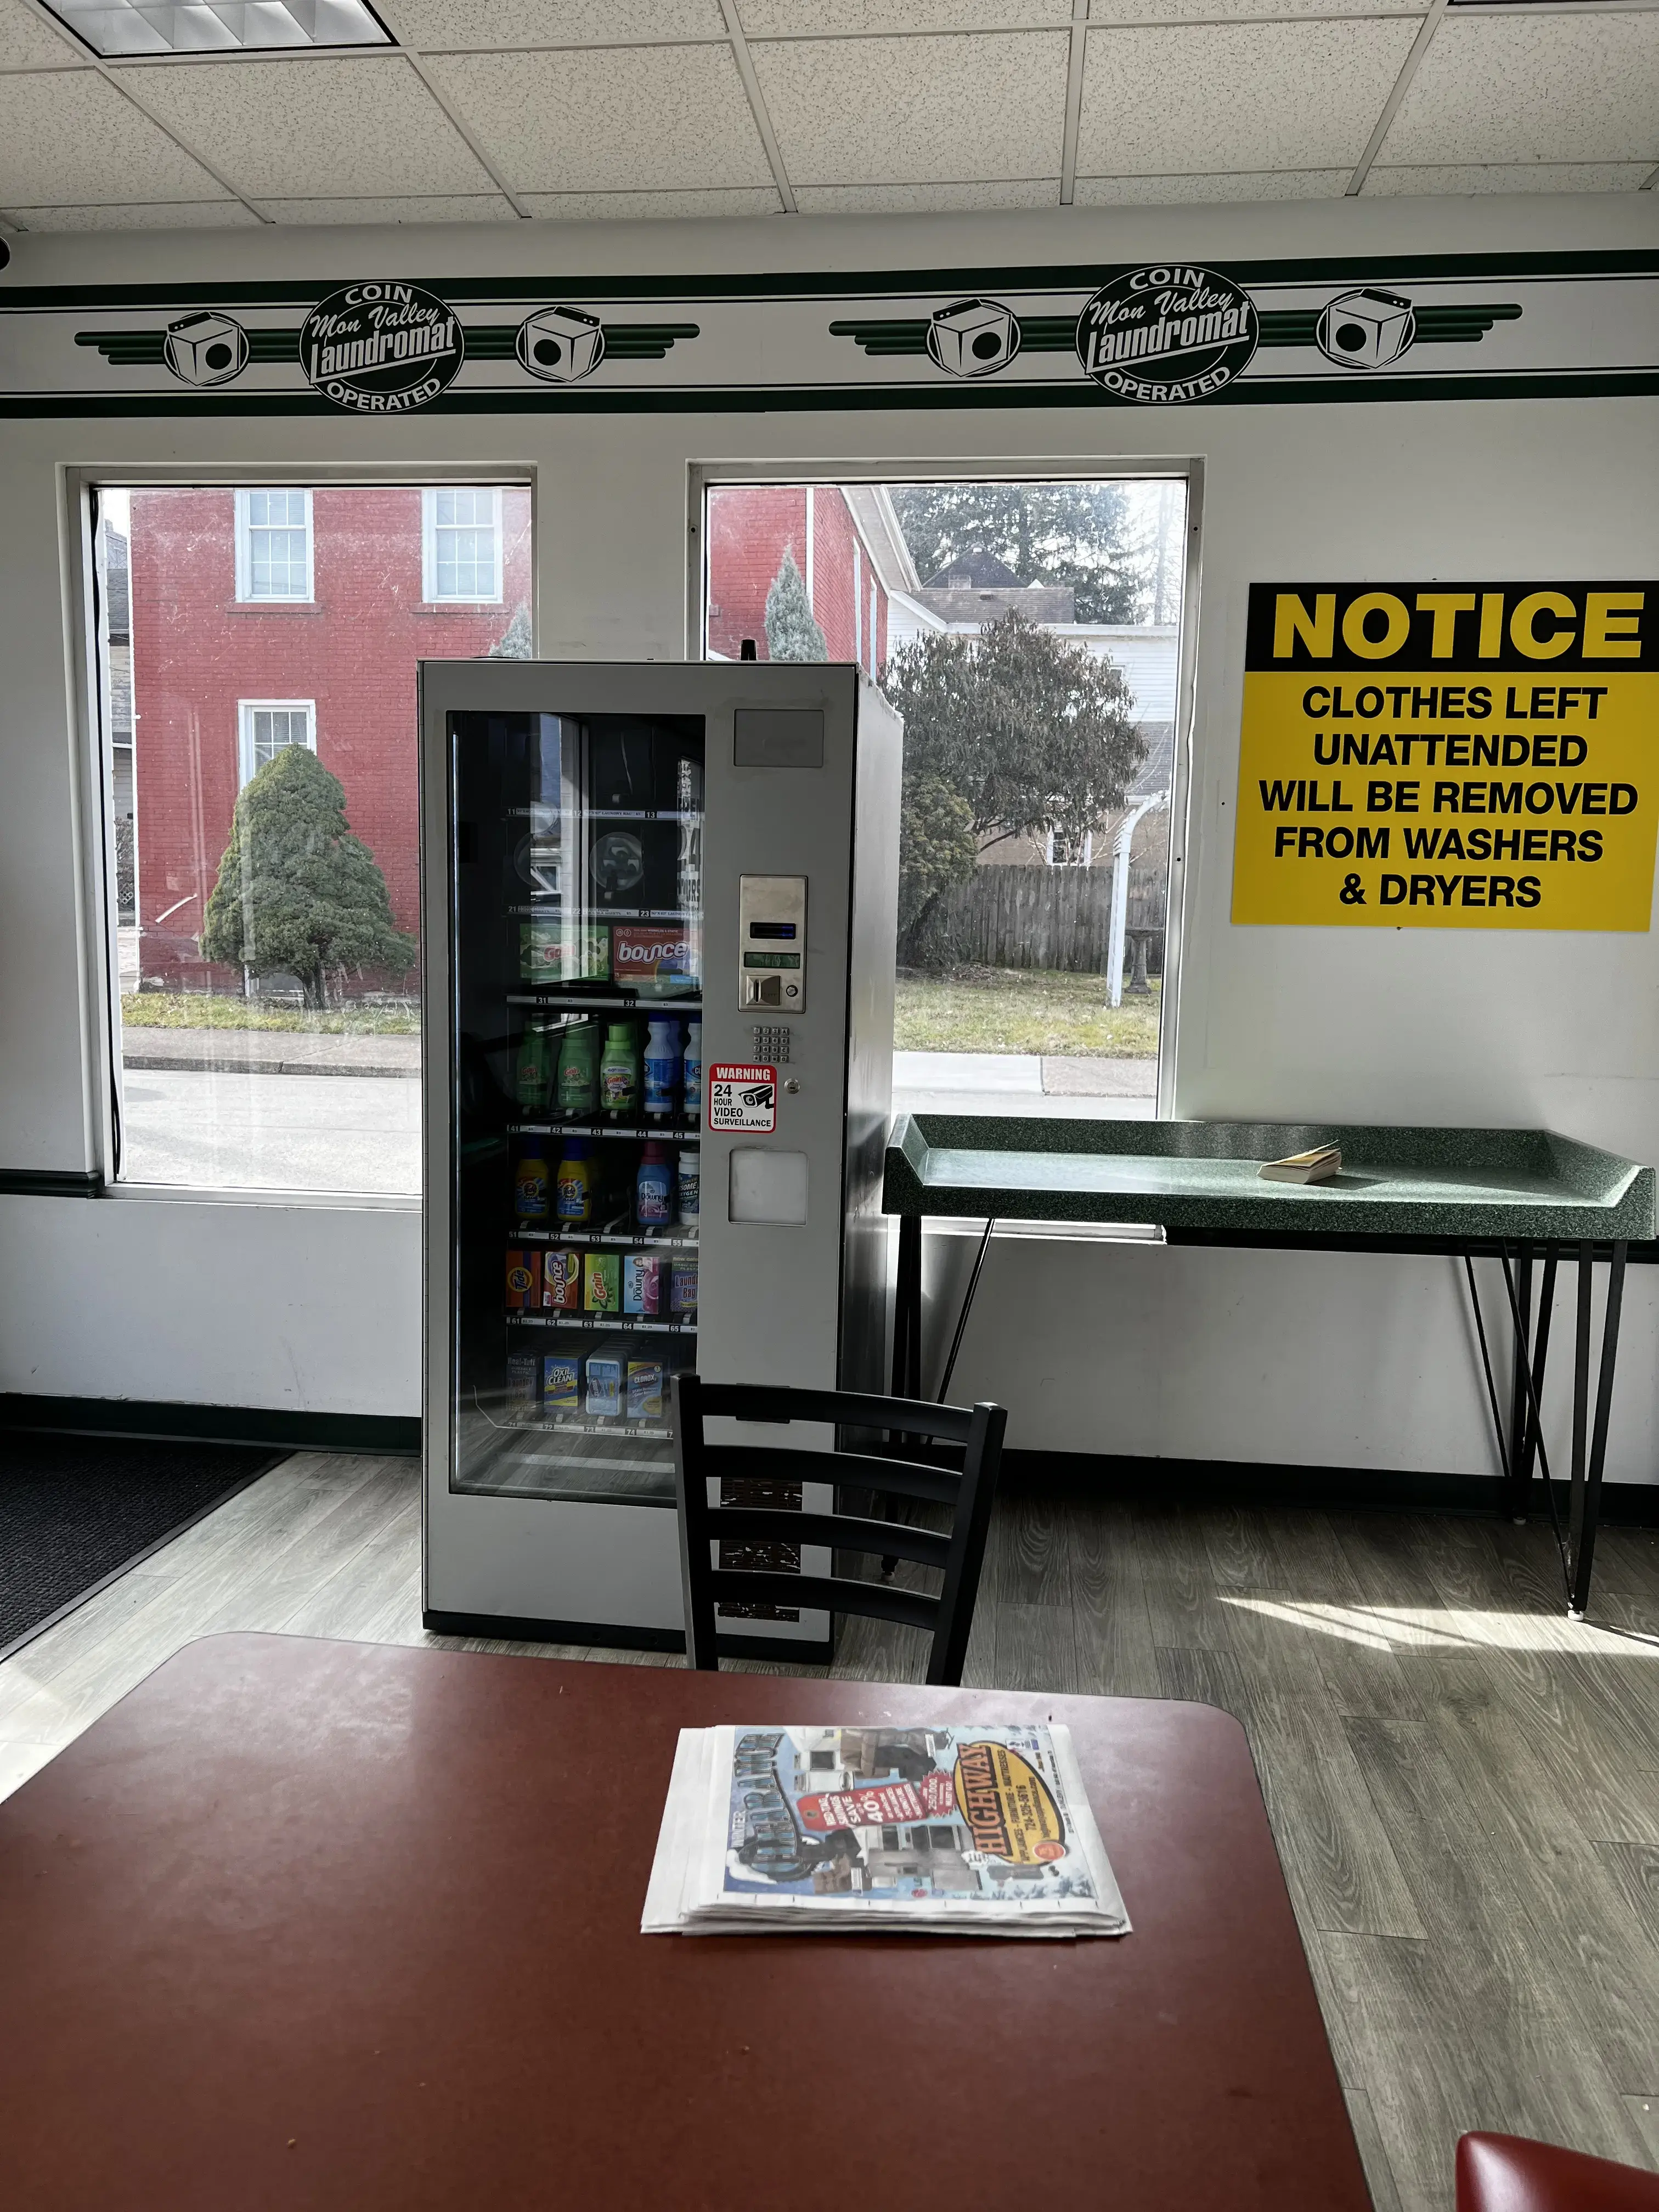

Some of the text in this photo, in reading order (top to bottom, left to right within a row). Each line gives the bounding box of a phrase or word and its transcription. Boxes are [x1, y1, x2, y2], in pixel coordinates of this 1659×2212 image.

[1130, 268, 1205, 290] COIN
[345, 285, 413, 304] COIN
[1089, 286, 1234, 325] Mon Valley
[310, 302, 440, 337] Mon Valley
[309, 316, 456, 384] Laundromat
[1086, 301, 1250, 374] Laundromat
[327, 378, 441, 410] OPERATED
[1104, 366, 1230, 401] OPERATED
[1273, 591, 1645, 659] NOTICE
[1302, 686, 1608, 720] CLOTHES LEFT
[1313, 733, 1588, 767] UNATTENDED
[1259, 780, 1639, 816] WILL BE REMOVED
[1274, 826, 1603, 862] FROM WASHERS
[1339, 873, 1542, 908] & DRYERS
[618, 941, 689, 963] bounce
[564, 1067, 579, 1076] Gain
[606, 1076, 622, 1085] Gain
[716, 1067, 770, 1081] WARNING
[714, 1084, 732, 1097] 24
[714, 1098, 732, 1106] HOUR
[713, 1118, 771, 1127] SURVEILLANCE
[714, 1107, 743, 1117] VIDEO
[524, 1184, 537, 1194] Tide
[563, 1186, 576, 1195] Tide
[641, 1193, 663, 1203] Downy
[514, 1269, 528, 1289] Tide
[552, 1261, 566, 1304] bounce
[592, 1272, 607, 1299] Gain
[633, 1269, 645, 1301] Downy
[548, 1374, 573, 1385] CLEAN
[553, 1368, 568, 1377] OXI
[842, 1796, 861, 1824] SAVE
[859, 1791, 884, 1822] 40%
[957, 1742, 1013, 1856] HIGHWAY
